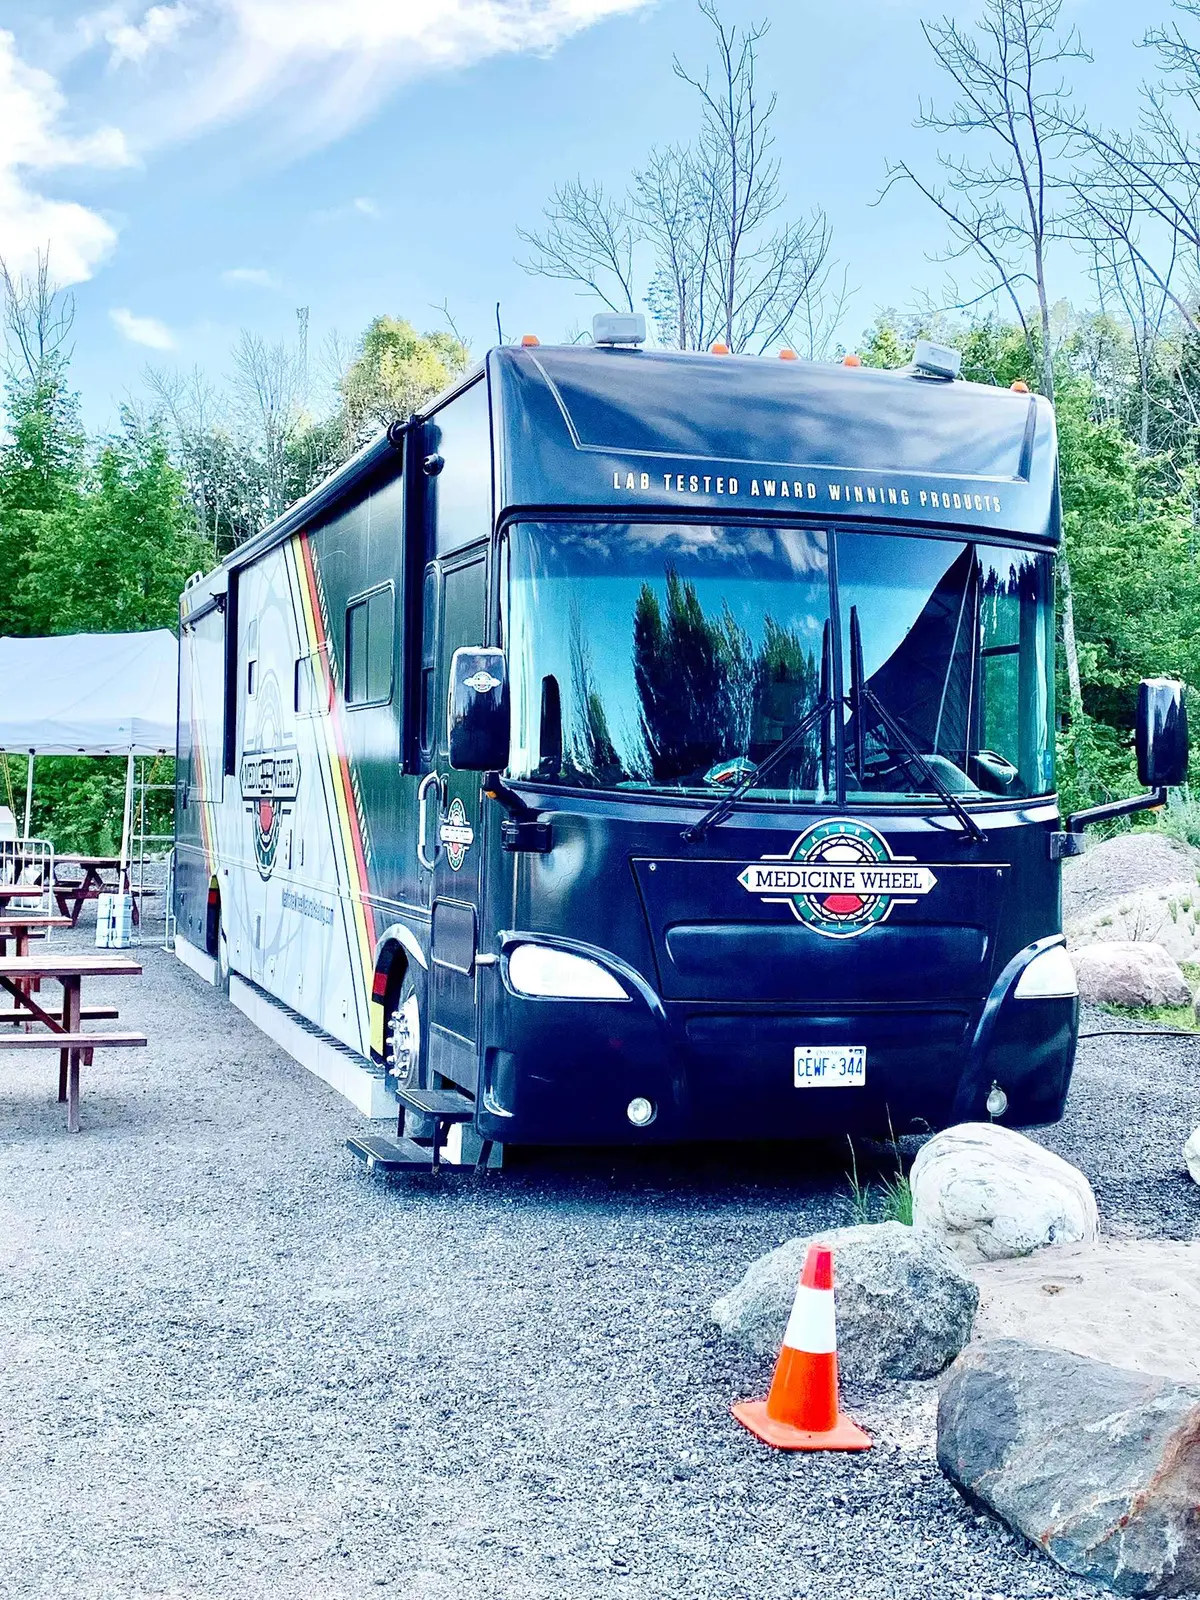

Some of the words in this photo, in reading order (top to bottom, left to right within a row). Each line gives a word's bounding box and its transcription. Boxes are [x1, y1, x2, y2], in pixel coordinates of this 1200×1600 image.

[613, 472, 650, 490] LAB
[663, 474, 738, 495] TESTED
[750, 483, 817, 500] AWARD
[828, 484, 910, 506] WINNING
[919, 489, 1002, 513] PRODUCTS
[799, 825, 883, 857] NATURAL
[755, 870, 855, 888] MEDICINE
[860, 872, 922, 889] WHEEL
